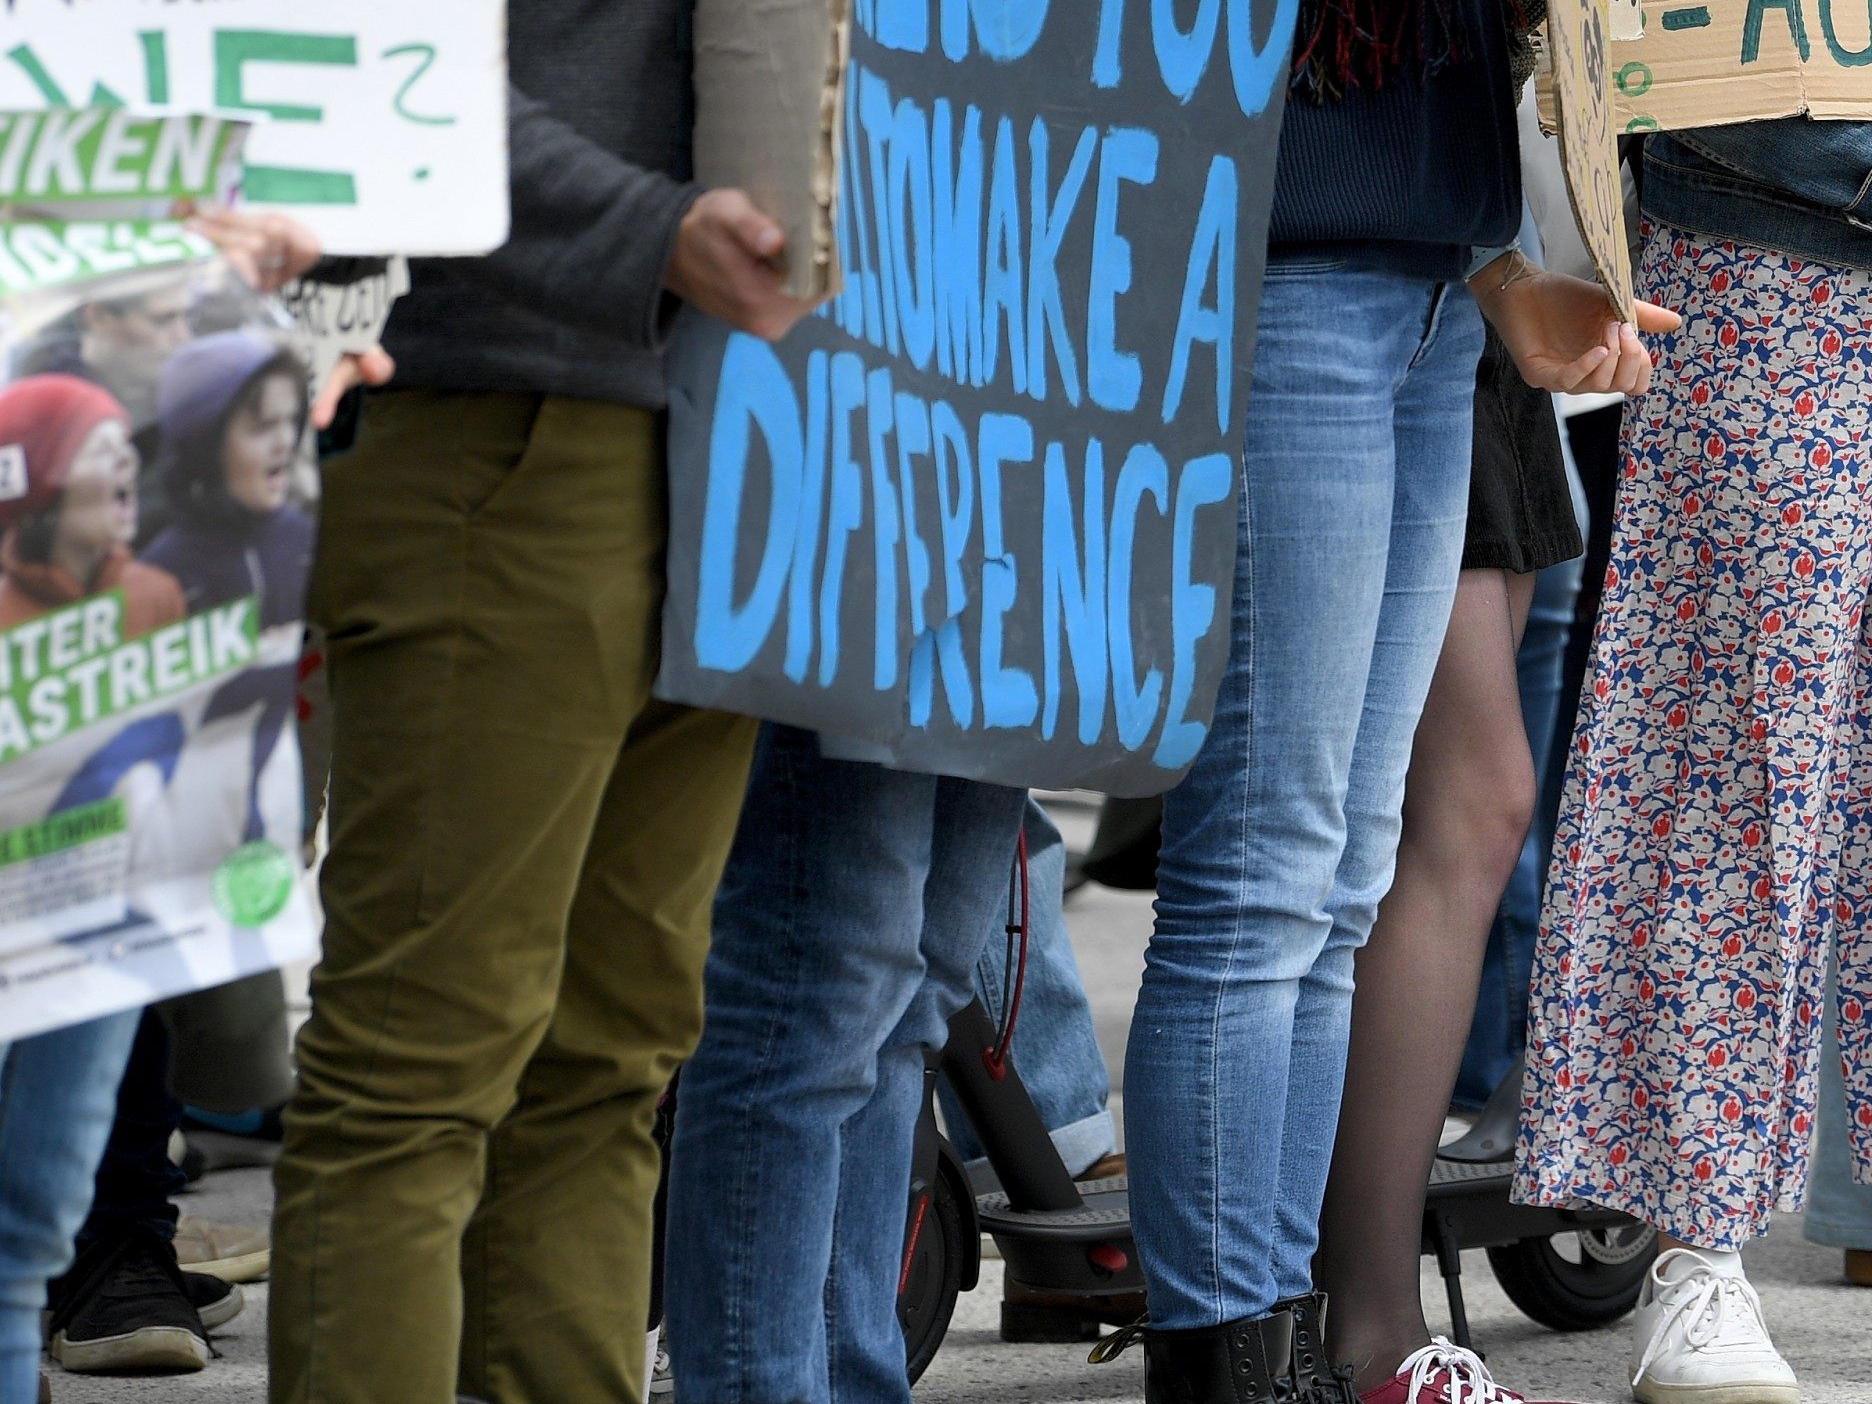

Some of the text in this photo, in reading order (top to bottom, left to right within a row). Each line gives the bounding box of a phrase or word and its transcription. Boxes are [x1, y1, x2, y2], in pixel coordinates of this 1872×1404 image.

[0, 111, 224, 196] IKEN
[931, 96, 1159, 412] MAKE
[1161, 153, 1238, 437] A
[693, 330, 1234, 771] DIFFERENCE
